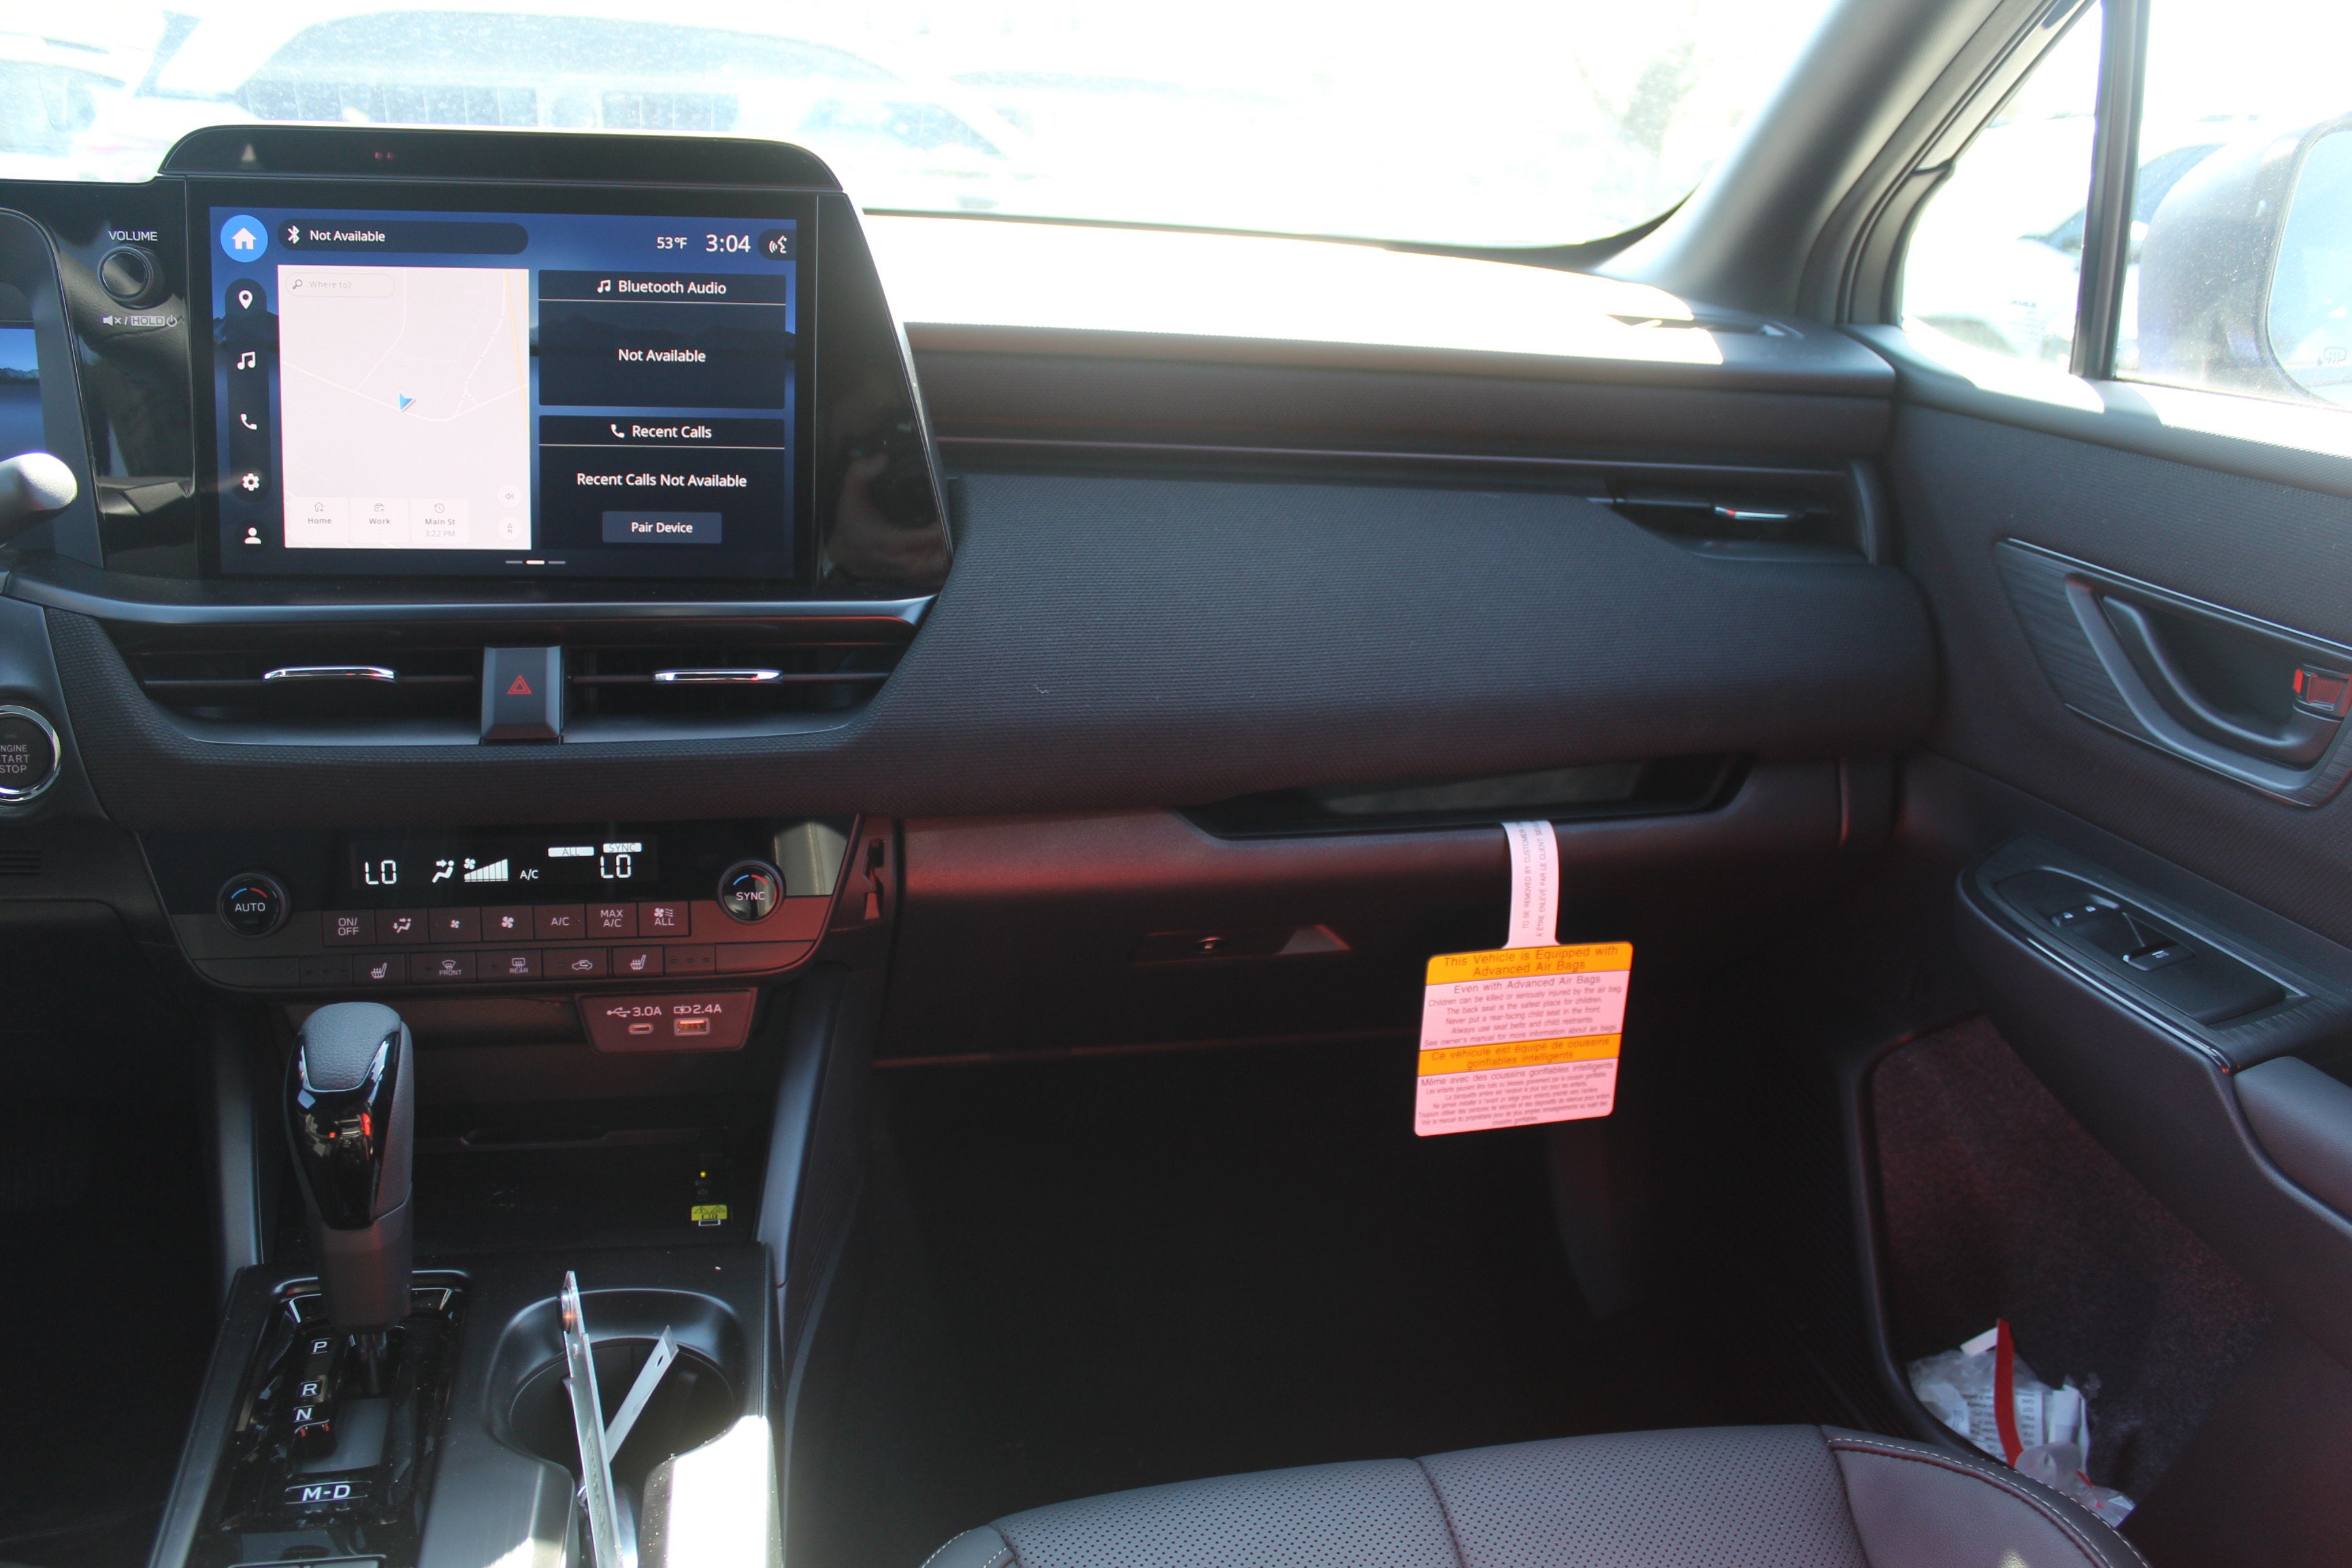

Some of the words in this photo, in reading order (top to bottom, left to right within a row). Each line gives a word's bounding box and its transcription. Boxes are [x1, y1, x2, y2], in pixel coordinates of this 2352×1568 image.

[108, 231, 157, 241] VOLUME
[310, 230, 331, 240] Not
[333, 231, 385, 242] Available
[706, 235, 751, 252] 3:04
[619, 280, 683, 293] Bluetooth
[687, 282, 726, 294] Audio
[133, 317, 163, 325] HOLD
[619, 349, 643, 361] Not
[646, 350, 706, 362] Available
[633, 425, 678, 438] Recent
[681, 426, 712, 438] Calls
[578, 473, 622, 485] Recent
[626, 474, 656, 485] Calls
[661, 474, 685, 486] Not
[687, 474, 747, 487] Available
[632, 522, 653, 532] Pair
[657, 523, 693, 533] Device
[0, 755, 29, 763] TART
[608, 843, 636, 852] SYNC
[1519, 829, 1531, 863] CUSTOMER
[1537, 838, 1546, 860] CLIENT
[562, 848, 579, 856] ALL
[600, 855, 631, 877] LO
[1524, 866, 1531, 874] BY
[365, 860, 397, 885] LO
[520, 869, 538, 880] A/C
[736, 892, 766, 900] SYNC
[235, 902, 265, 911] AUTO
[1523, 910, 1530, 919] BE
[339, 918, 357, 926] ON/
[551, 917, 569, 926] A/C
[604, 919, 621, 927] A/C
[655, 917, 674, 926] ALL
[1522, 920, 1529, 929] TO
[338, 927, 359, 936] OFF
[1443, 956, 1467, 967] This
[1473, 951, 1515, 964] Vehicle
[1520, 951, 1530, 960] is
[1535, 947, 1590, 960] Equipped
[1595, 945, 1618, 955] with
[1472, 962, 1531, 977] Advanced
[1535, 961, 1552, 972] Air
[1556, 958, 1586, 973] Bags
[1454, 985, 1478, 994] Even
[1482, 981, 1502, 991] with
[1506, 977, 1555, 989] Advanced
[1558, 976, 1572, 985] Air
[1575, 975, 1600, 985] Bags
[633, 1007, 662, 1016] 3.0A
[693, 1004, 721, 1013] 2.4A
[1431, 1051, 1446, 1061] Ce
[1450, 1047, 1491, 1058] véhicule
[1494, 1045, 1510, 1055] est
[1551, 1041, 1563, 1049] de
[1567, 1037, 1610, 1048] coussins
[1467, 1054, 1518, 1070] gonflables
[1521, 1049, 1574, 1064] intelligents
[1450, 1075, 1469, 1084] avec
[1490, 1070, 1526, 1080] coussins
[1529, 1066, 1569, 1078] gonflables
[1572, 1062, 1614, 1073] intelligents
[313, 1341, 327, 1352] P
[302, 1384, 317, 1396] R
[296, 1408, 312, 1421] N
[302, 1484, 350, 1501] M-D
